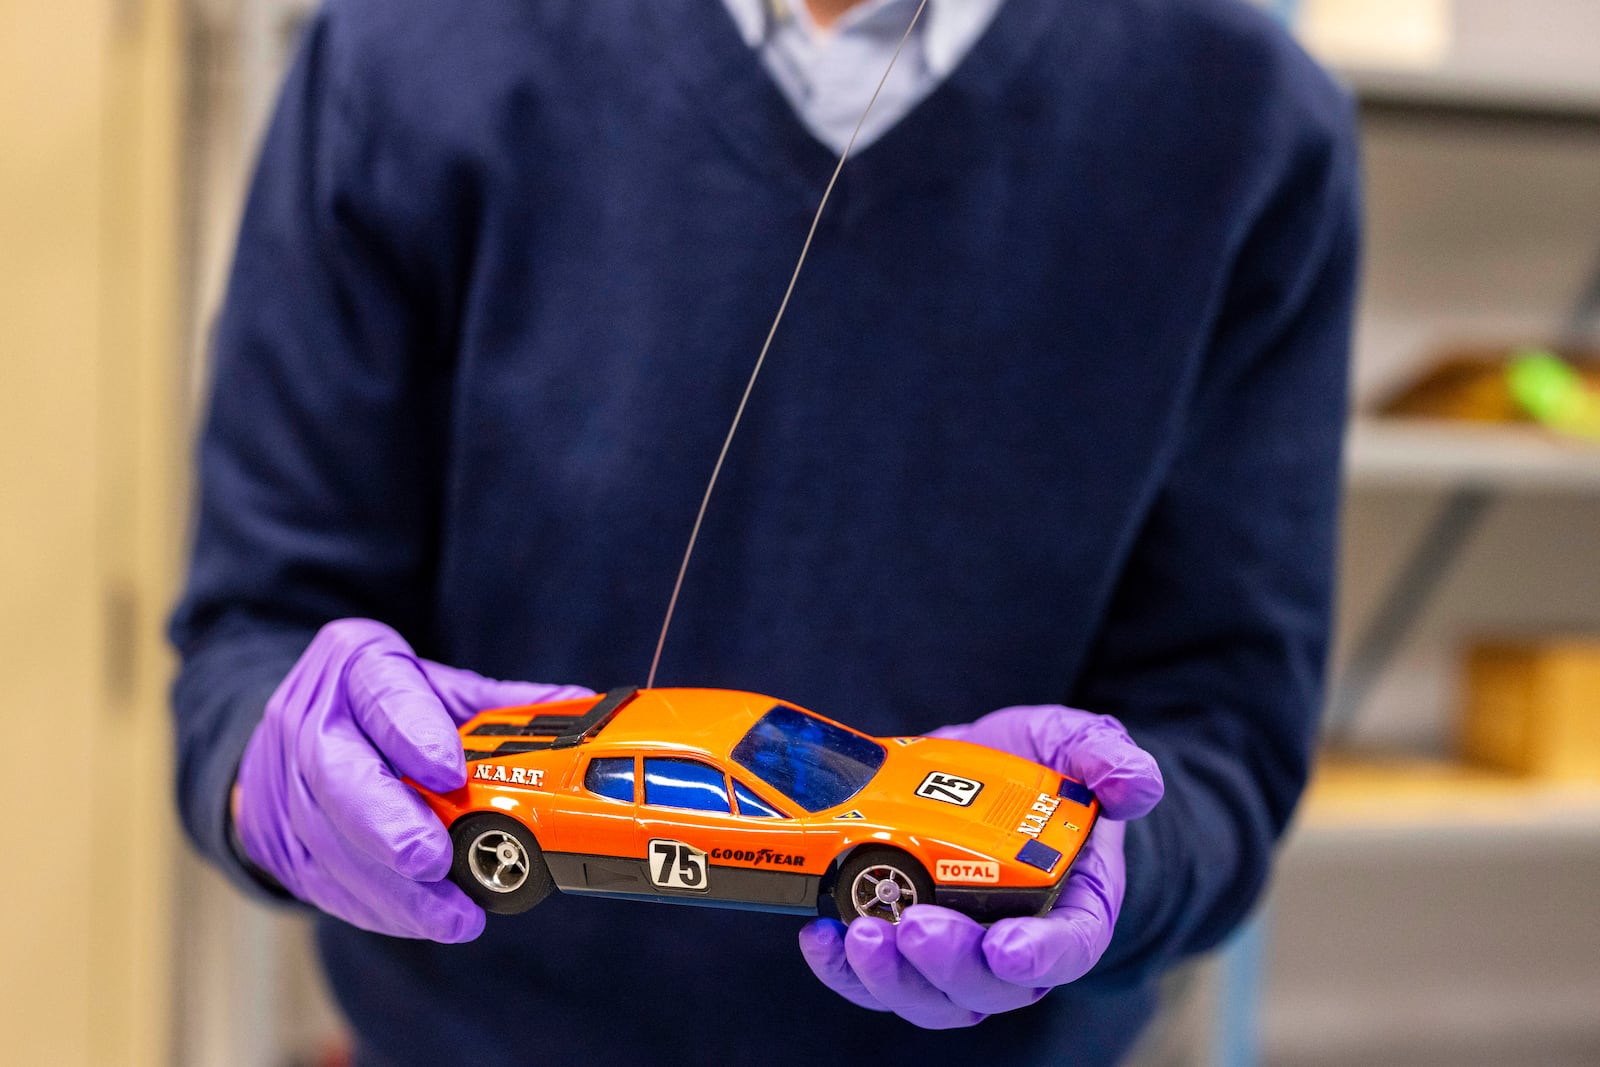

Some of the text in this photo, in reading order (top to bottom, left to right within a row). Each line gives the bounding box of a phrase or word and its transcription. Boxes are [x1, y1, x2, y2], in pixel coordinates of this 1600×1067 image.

[474, 764, 544, 786] N.A.R.T.
[923, 775, 975, 803] 75
[654, 844, 702, 886] 75
[940, 864, 995, 878] TOTAL
